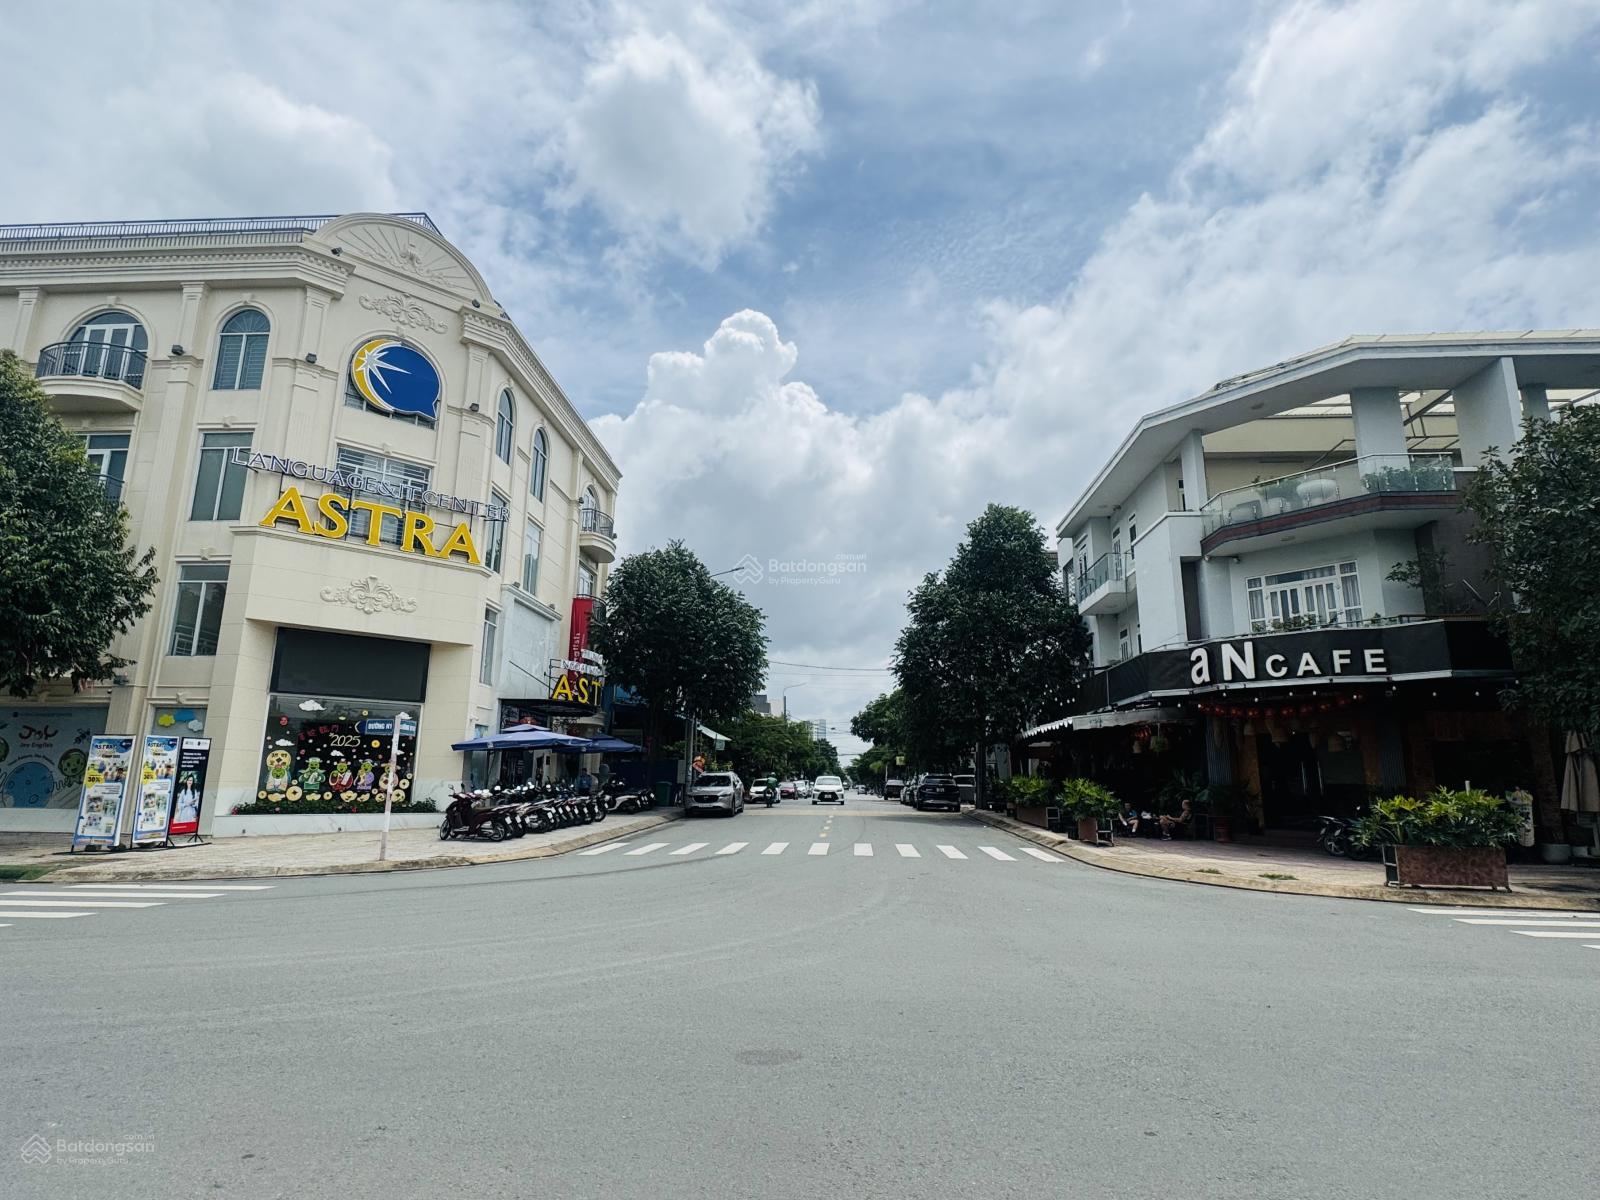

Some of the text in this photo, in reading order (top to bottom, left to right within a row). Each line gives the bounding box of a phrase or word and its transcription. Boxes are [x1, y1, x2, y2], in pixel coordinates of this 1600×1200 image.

[231, 446, 378, 494] LANGUAGE
[421, 490, 510, 521] CENTER
[258, 486, 480, 565] ASTRA
[1189, 641, 1387, 685] aN CAFE
[330, 735, 361, 747] 2025
